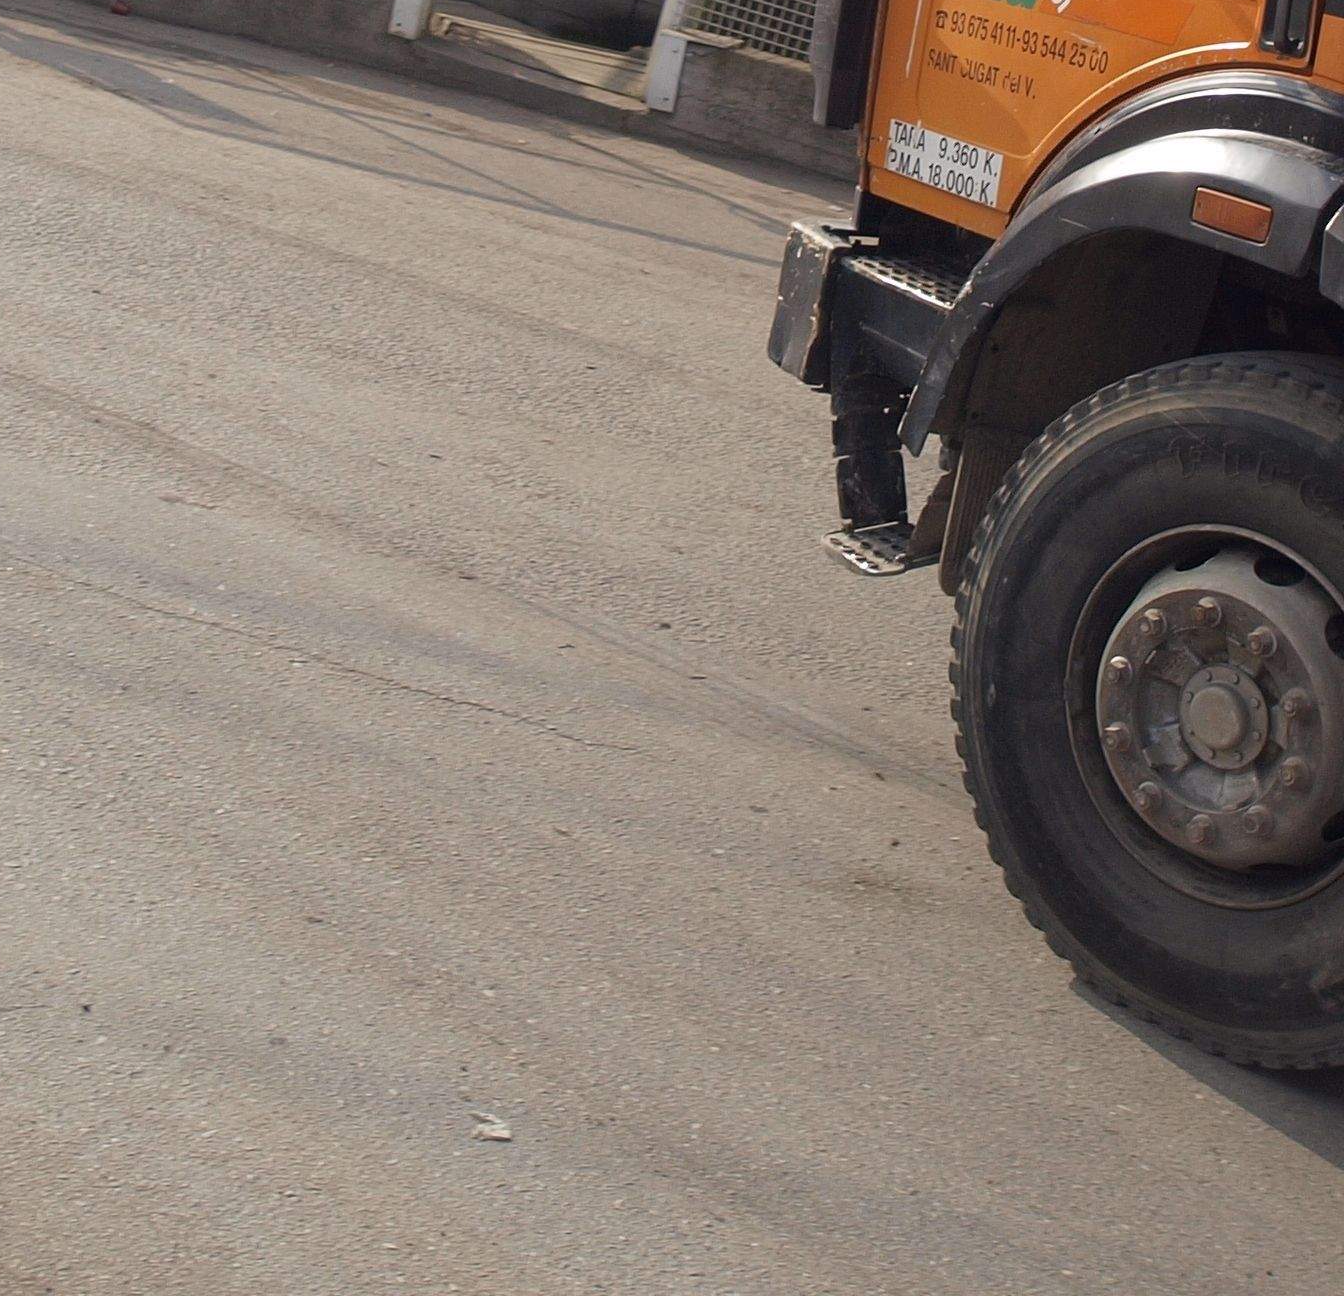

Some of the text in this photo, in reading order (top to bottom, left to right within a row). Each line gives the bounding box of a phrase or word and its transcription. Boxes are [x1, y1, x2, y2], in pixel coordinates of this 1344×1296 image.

[951, 11, 966, 34] 93
[967, 15, 989, 41] 675
[1041, 35, 1067, 63] 544
[1069, 42, 1087, 69] 25
[1089, 49, 1109, 74] 00
[927, 48, 958, 75] SANT
[960, 58, 1000, 88] CUGAT
[1024, 75, 1036, 99] V.
[888, 147, 994, 205] P.M.A. 18.000 K.
[938, 137, 979, 170] 9.360
[983, 151, 998, 177] K.
